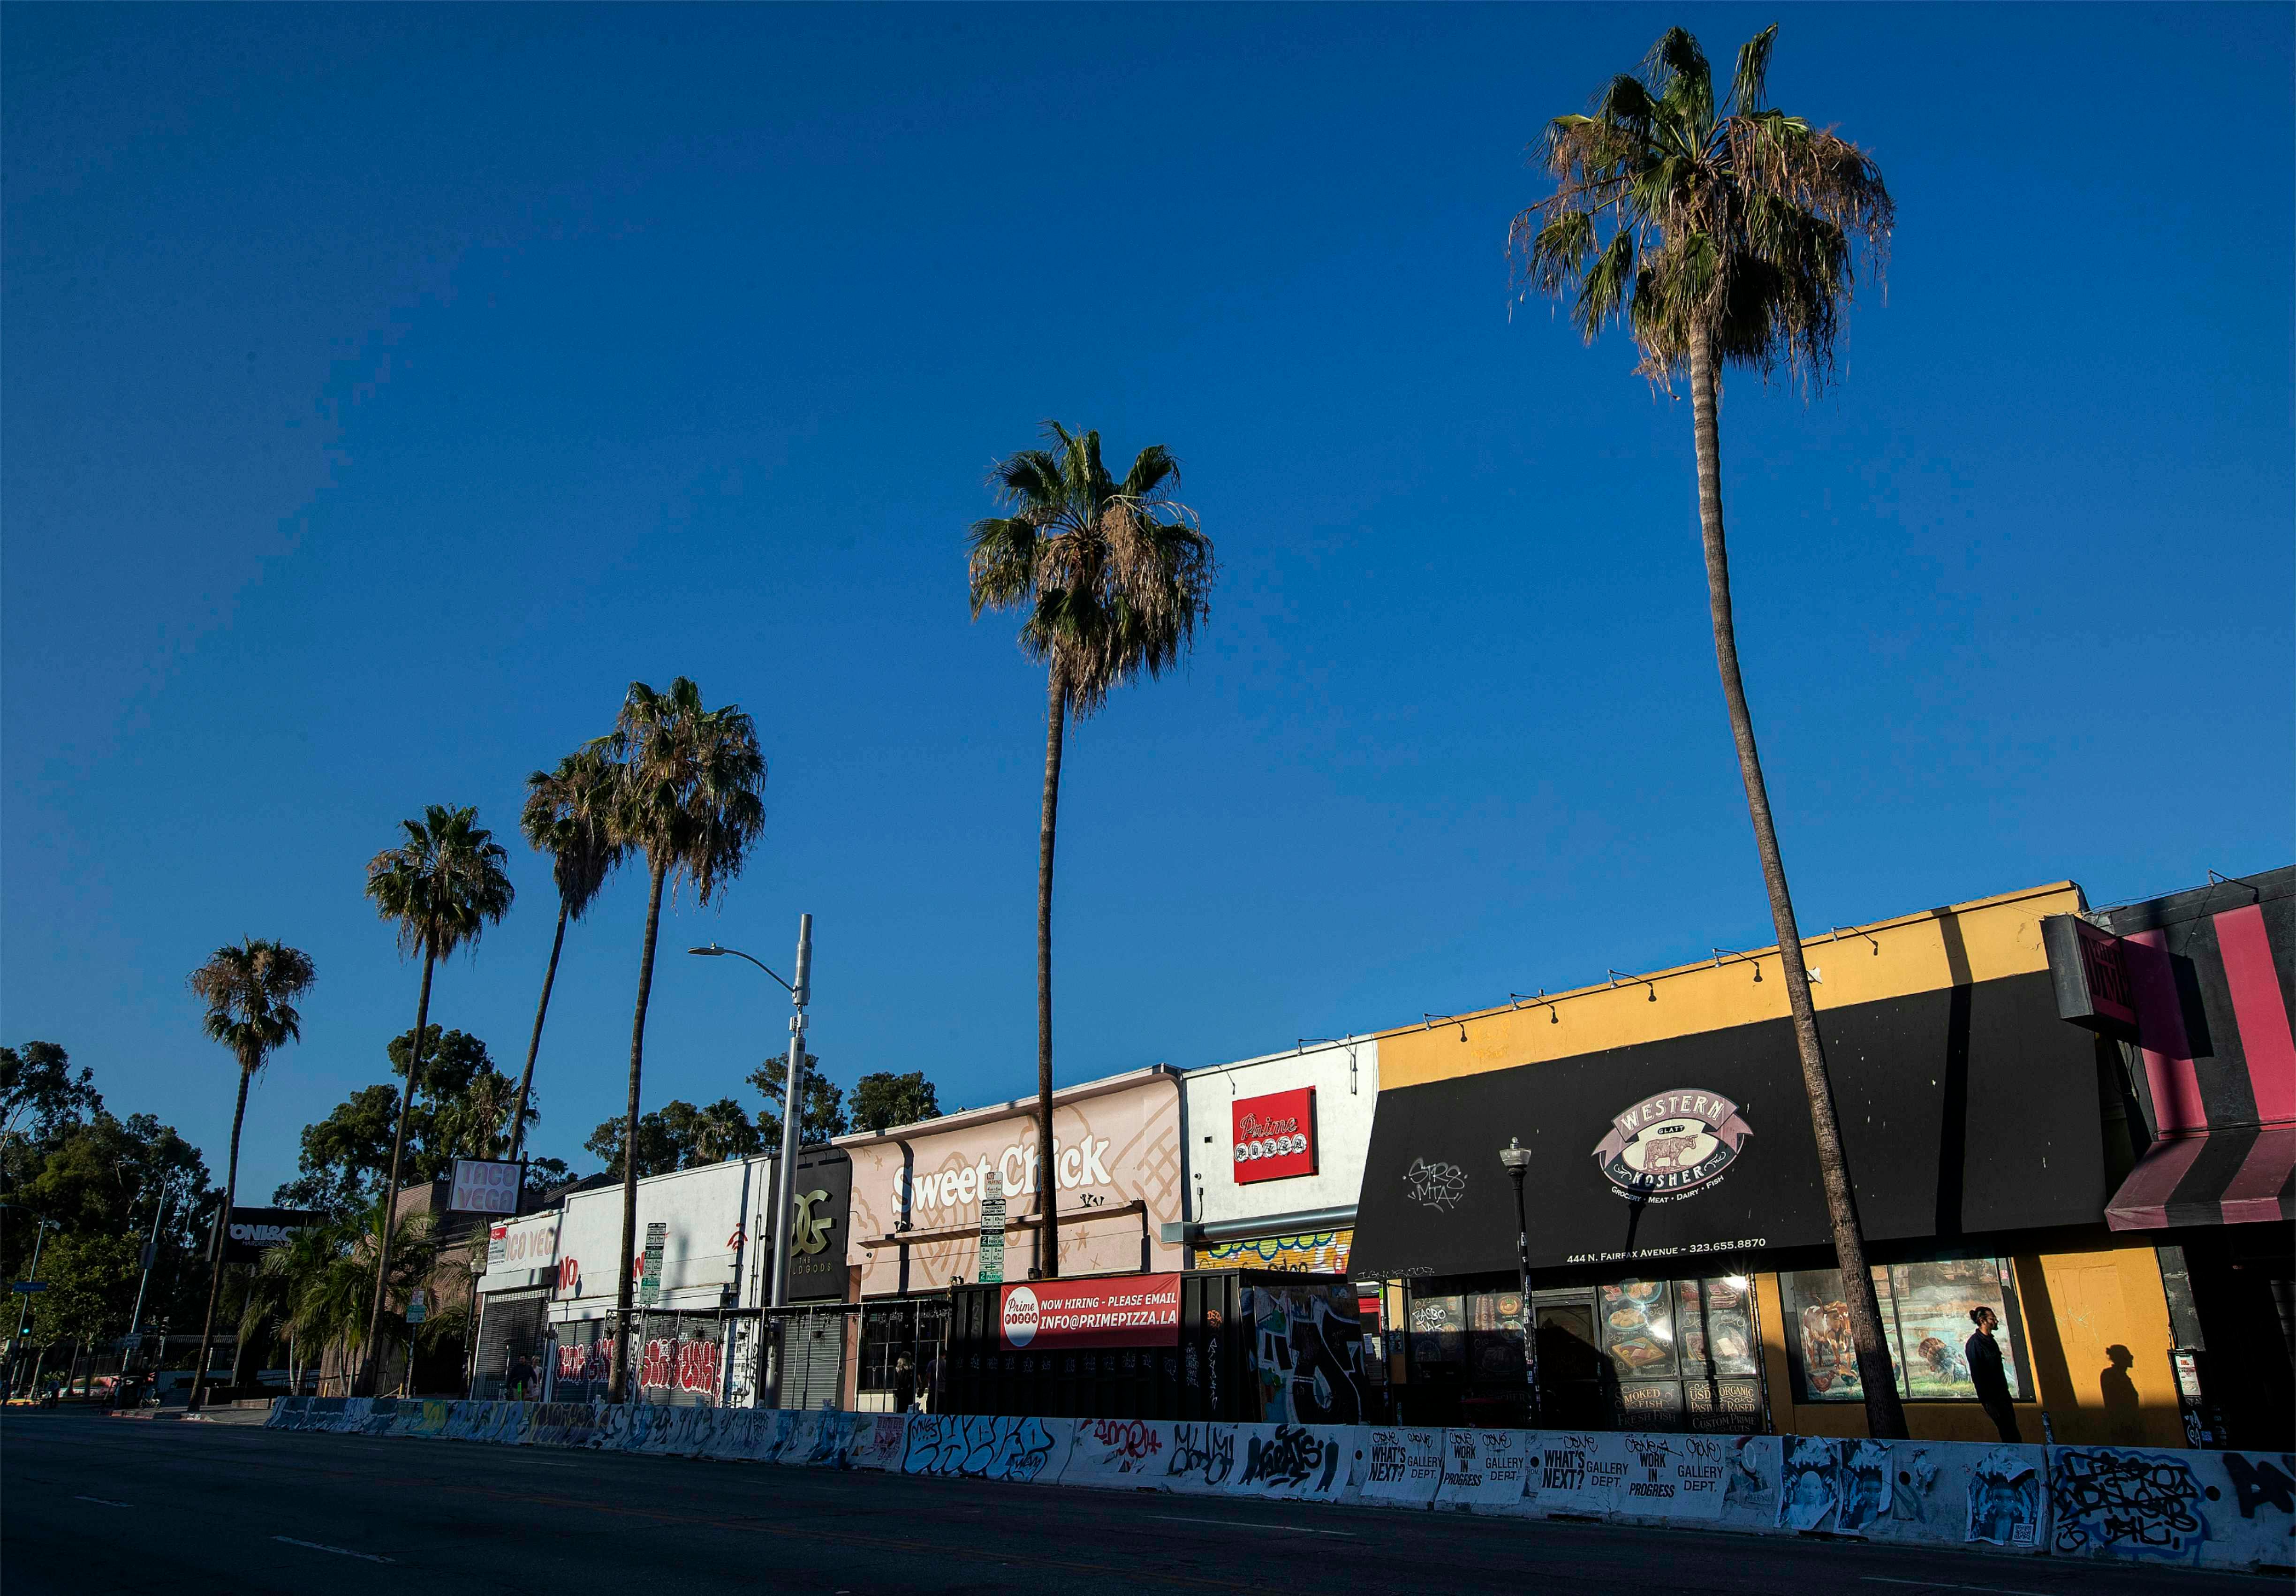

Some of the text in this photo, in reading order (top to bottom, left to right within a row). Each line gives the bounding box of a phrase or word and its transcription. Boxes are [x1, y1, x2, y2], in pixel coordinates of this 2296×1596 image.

[1621, 1096, 1724, 1131] WESTERN
[1240, 1113, 1297, 1141] Prime
[1659, 1126, 1684, 1135] GLATT
[461, 1162, 517, 1187] TACO
[1632, 1165, 1705, 1188] KOSHER
[892, 1155, 991, 1213] Sweet
[1611, 1186, 1642, 1202] GROCERY
[1676, 1189, 1699, 1201] DAIRY
[1706, 1175, 1724, 1189] FISH
[457, 1187, 514, 1211] VEGA
[1600, 1251, 1637, 1261] FAIRFAX
[1640, 1247, 1678, 1257] AVENUE
[1690, 1238, 1766, 1253] 323.655.8870
[559, 1256, 578, 1291] NO
[1008, 1297, 1035, 1312] Prime
[1040, 1300, 1063, 1310] NOW
[1064, 1297, 1099, 1309] HIRING
[1107, 1294, 1143, 1307] PLEASE
[1145, 1292, 1177, 1305] EMAIL
[1005, 1313, 1038, 1325] PIZZA
[1039, 1309, 1177, 1330] INFO@PRIMEPIZZA.LA
[1690, 1386, 1754, 1400] USDA ORGANIC
[1638, 1400, 1663, 1408] FISH
[1690, 1401, 1756, 1413] PASTURE RAISED
[1617, 1409, 1676, 1426] FRESH FISH
[1692, 1413, 1757, 1430] CUSTOM PRIME
[1372, 1446, 1406, 1463] WHAT'S
[1455, 1445, 1476, 1460] WORK
[1545, 1449, 1585, 1469] WHAT'S
[1408, 1456, 1443, 1467] GALLERY
[1460, 1459, 1469, 1473] IN
[1485, 1457, 1524, 1469] GALLERY
[1586, 1461, 1629, 1475] GALLERY
[1640, 1453, 1666, 1468] WORK
[1368, 1463, 1405, 1482] NEXT?
[1411, 1469, 1436, 1479] DEPT.
[1443, 1472, 1482, 1487] PROGRESS
[1490, 1471, 1518, 1481] DEPT.
[1542, 1468, 1585, 1490] NEXT?
[1648, 1468, 1657, 1483] IN
[1678, 1465, 1724, 1479] GALLERY
[1591, 1476, 1622, 1488] DEPT.
[1684, 1480, 1717, 1492] DEPT.
[1629, 1482, 1675, 1498] PROGRESS
